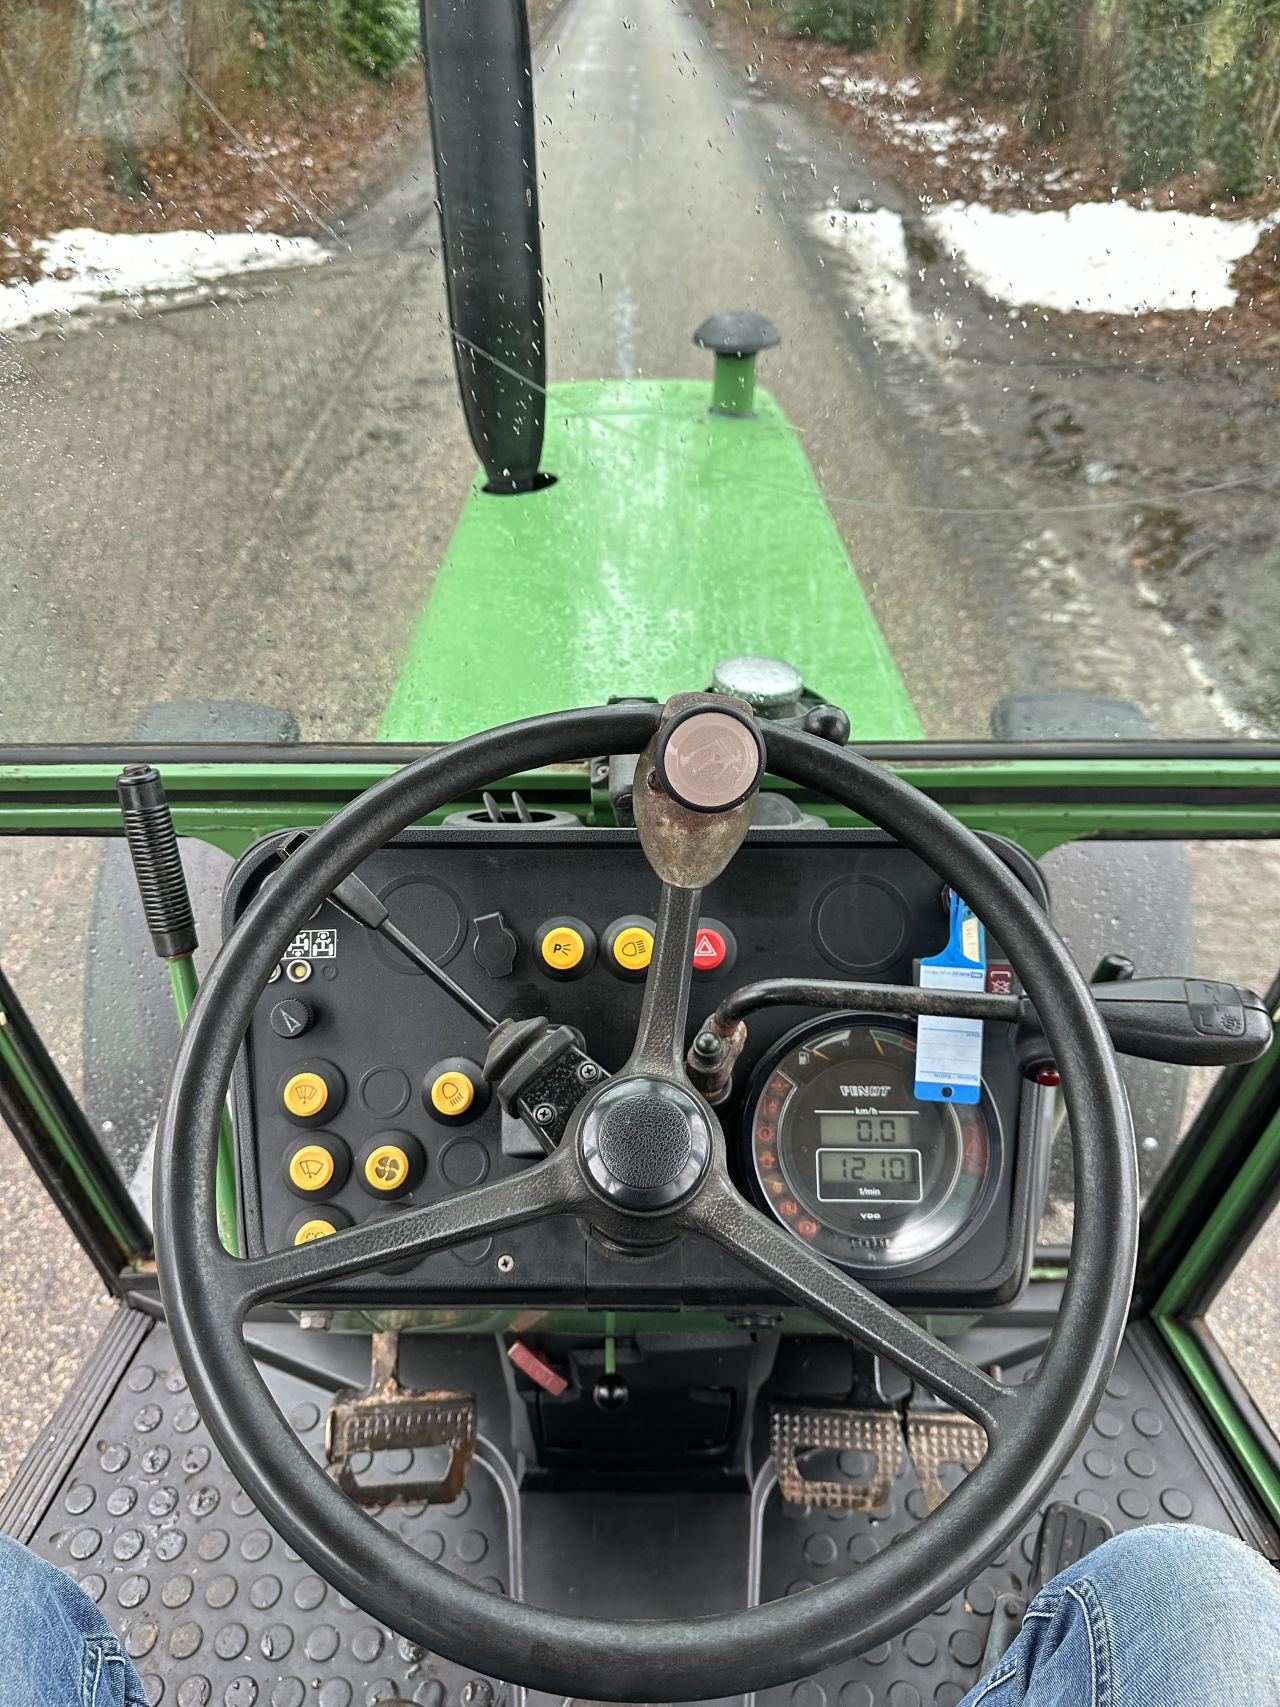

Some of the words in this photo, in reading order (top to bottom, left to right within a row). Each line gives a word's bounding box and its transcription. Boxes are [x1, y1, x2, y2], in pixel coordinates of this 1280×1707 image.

[839, 1085, 892, 1097] FENDT
[854, 1107, 878, 1115] km/h
[857, 1119, 896, 1142] 0.0
[858, 1187, 881, 1196] 1/min
